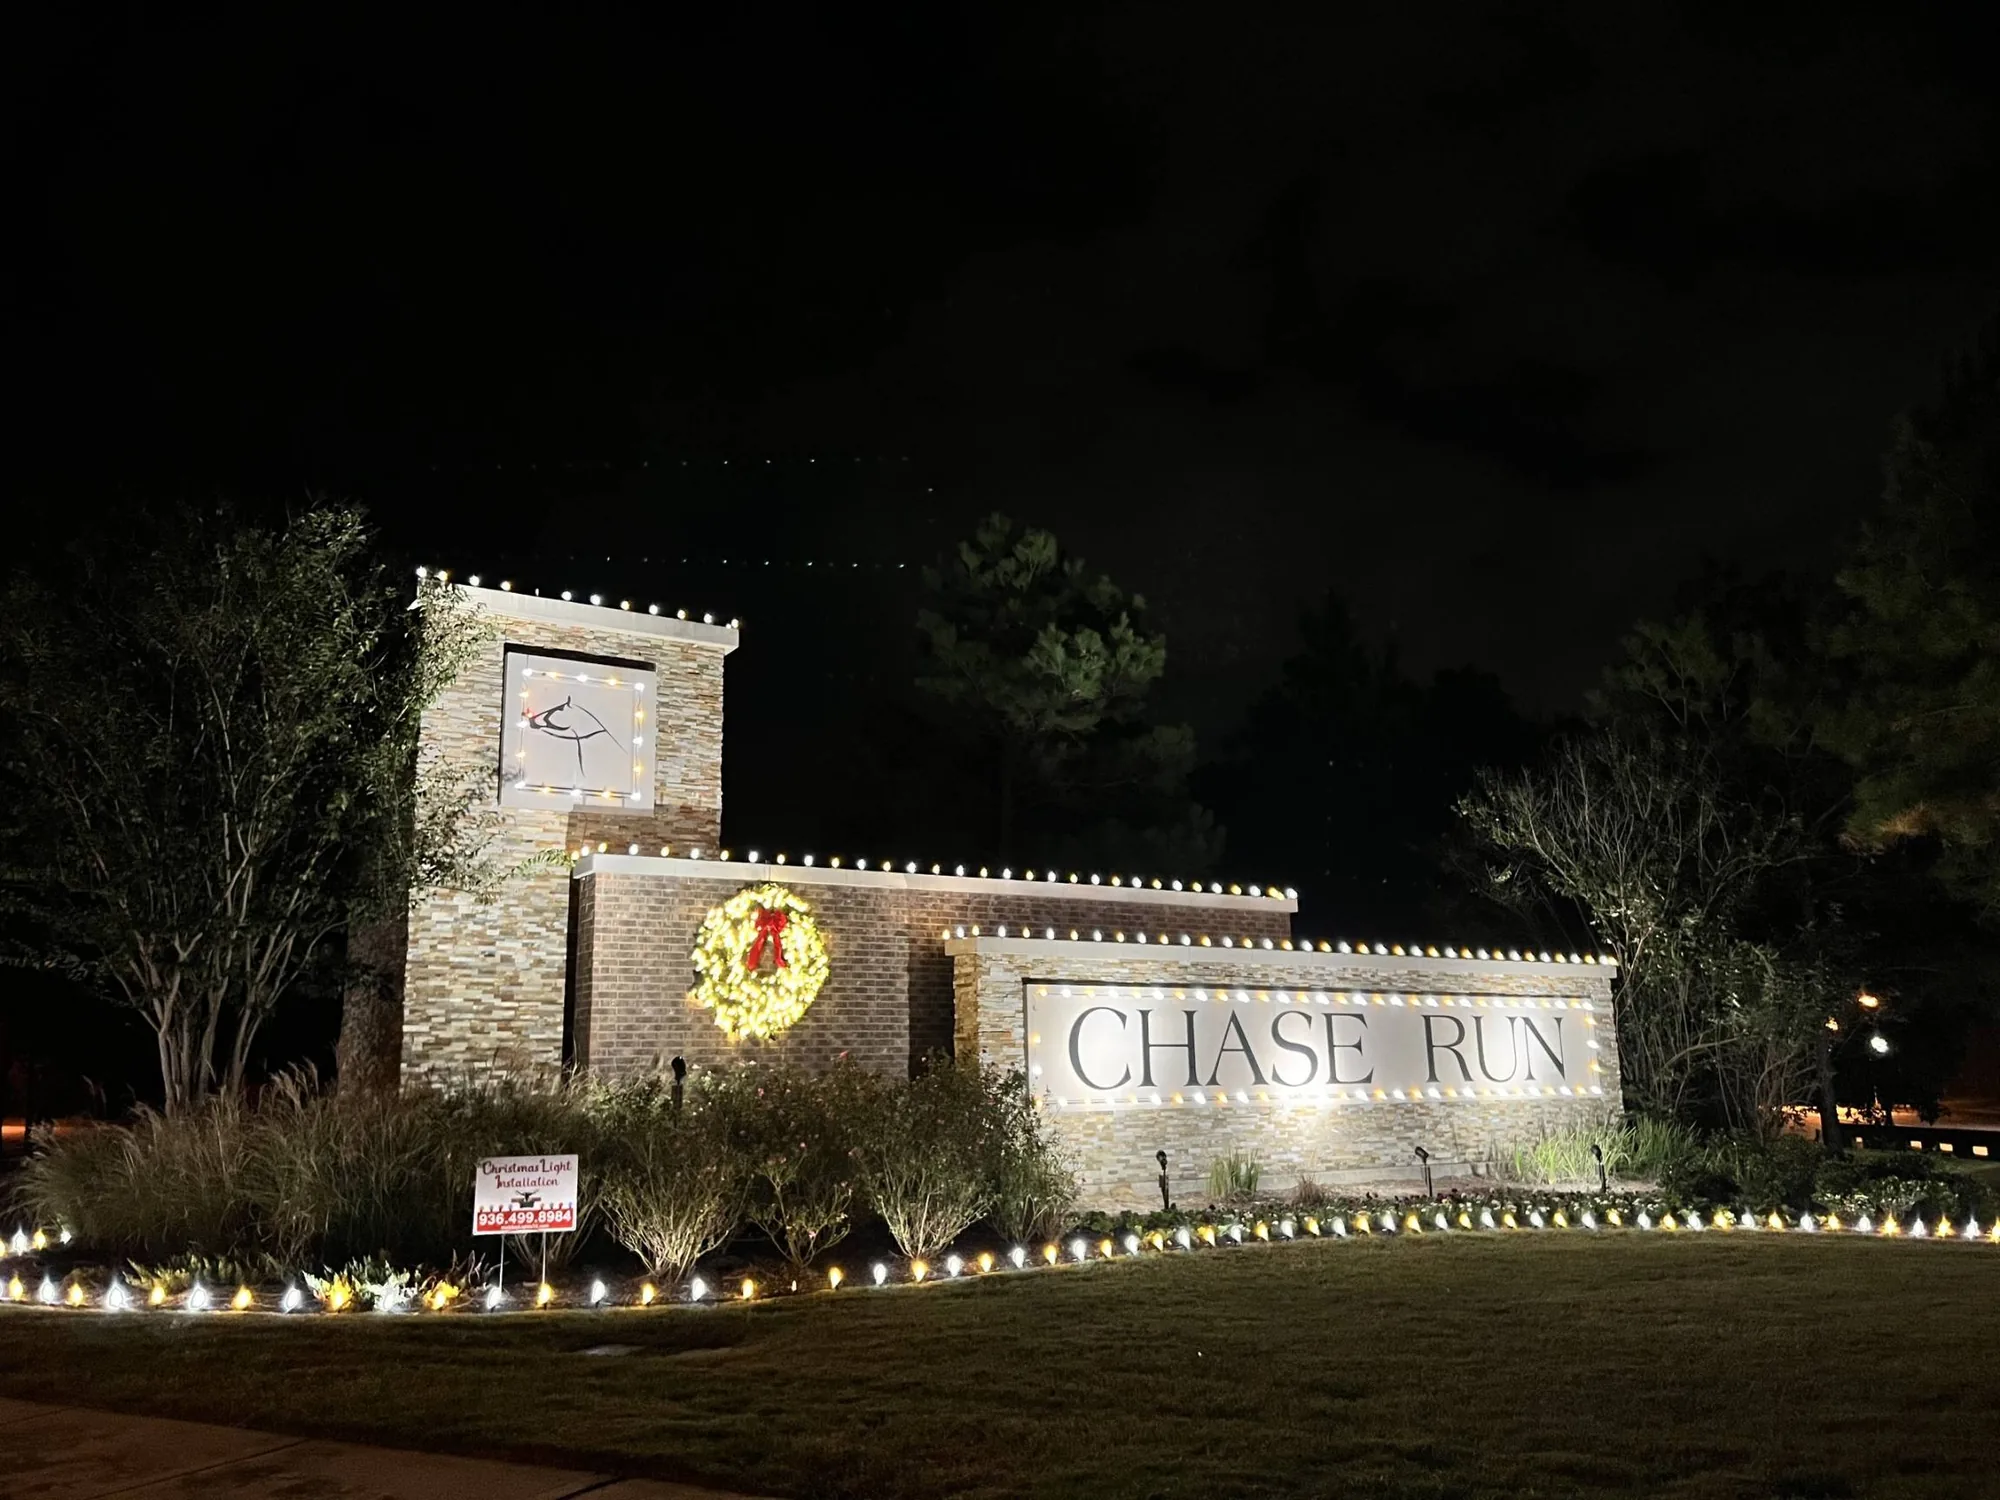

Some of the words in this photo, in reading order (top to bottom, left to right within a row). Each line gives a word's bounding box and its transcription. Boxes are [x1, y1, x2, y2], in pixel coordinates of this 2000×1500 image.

[1068, 1007, 1373, 1090] CHASE
[1422, 1014, 1566, 1083] RUN
[482, 1160, 539, 1175] Christmas
[539, 1158, 572, 1175] Light
[495, 1175, 559, 1189] Installation
[479, 1210, 572, 1226] 936.499.8984
